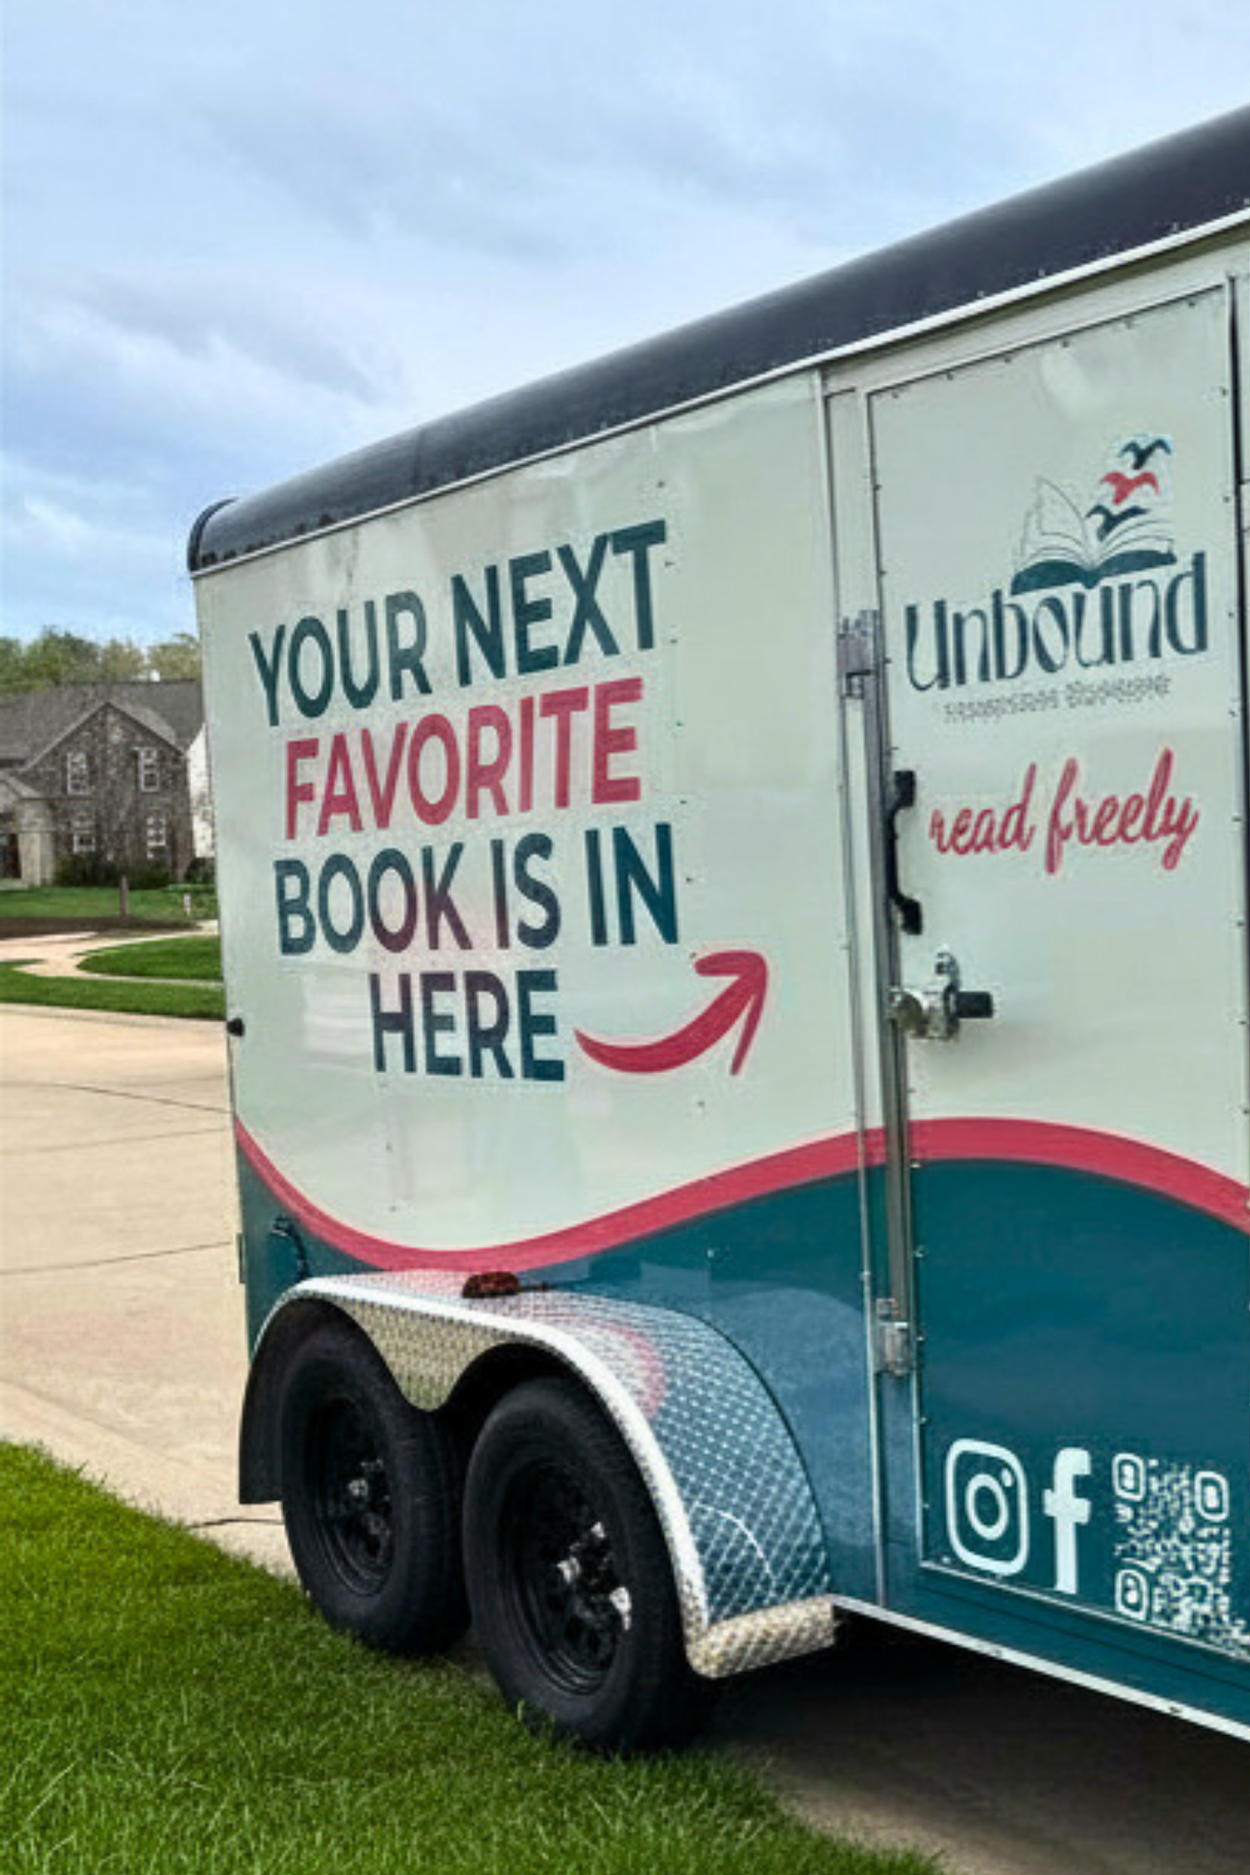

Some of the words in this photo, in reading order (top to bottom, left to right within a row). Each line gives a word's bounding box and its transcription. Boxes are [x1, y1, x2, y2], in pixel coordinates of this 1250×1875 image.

[248, 590, 432, 727] YOUR
[450, 519, 667, 687] NEXT
[905, 550, 1208, 692] Unbound
[286, 677, 644, 840] FAVORITE
[928, 762, 1037, 856] read
[1045, 747, 1199, 875] freely
[274, 842, 473, 956] BOOK
[491, 832, 561, 950] IS
[584, 822, 679, 947] IN
[369, 969, 565, 1082] HERE
